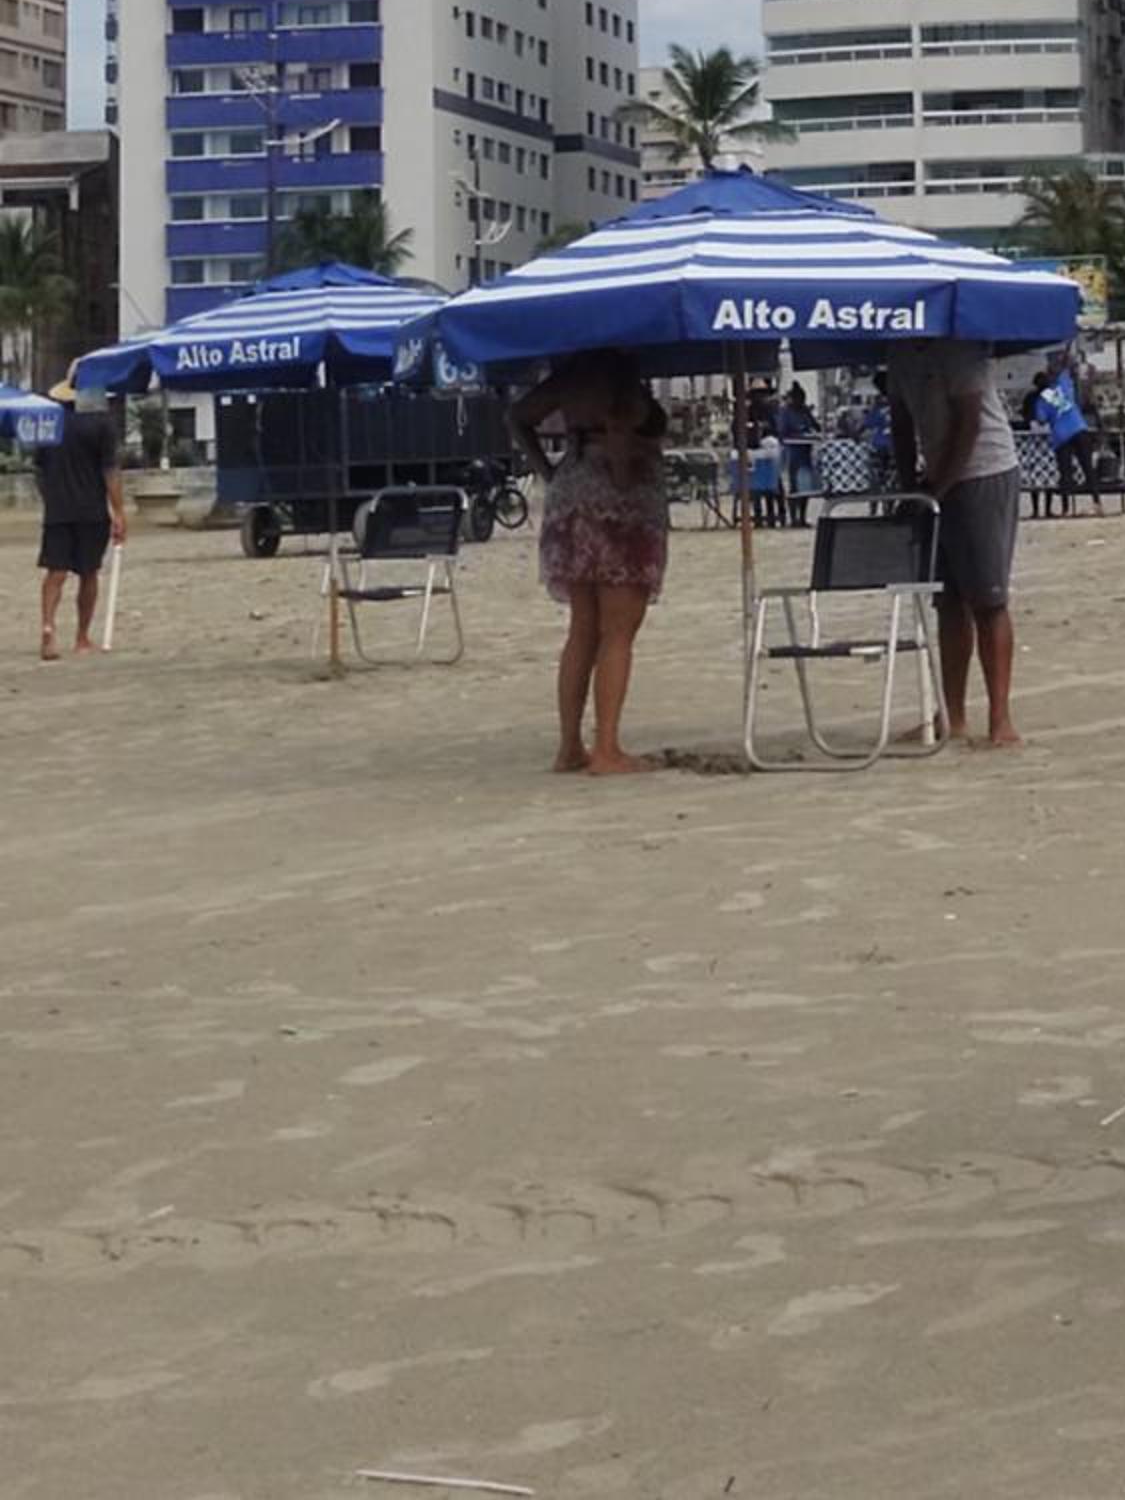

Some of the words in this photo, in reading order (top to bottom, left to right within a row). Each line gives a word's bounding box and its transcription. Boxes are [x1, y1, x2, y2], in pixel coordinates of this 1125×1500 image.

[712, 299, 796, 330] Alto
[807, 299, 925, 330] Astral
[176, 344, 223, 370] Alto
[229, 336, 300, 364] Astral
